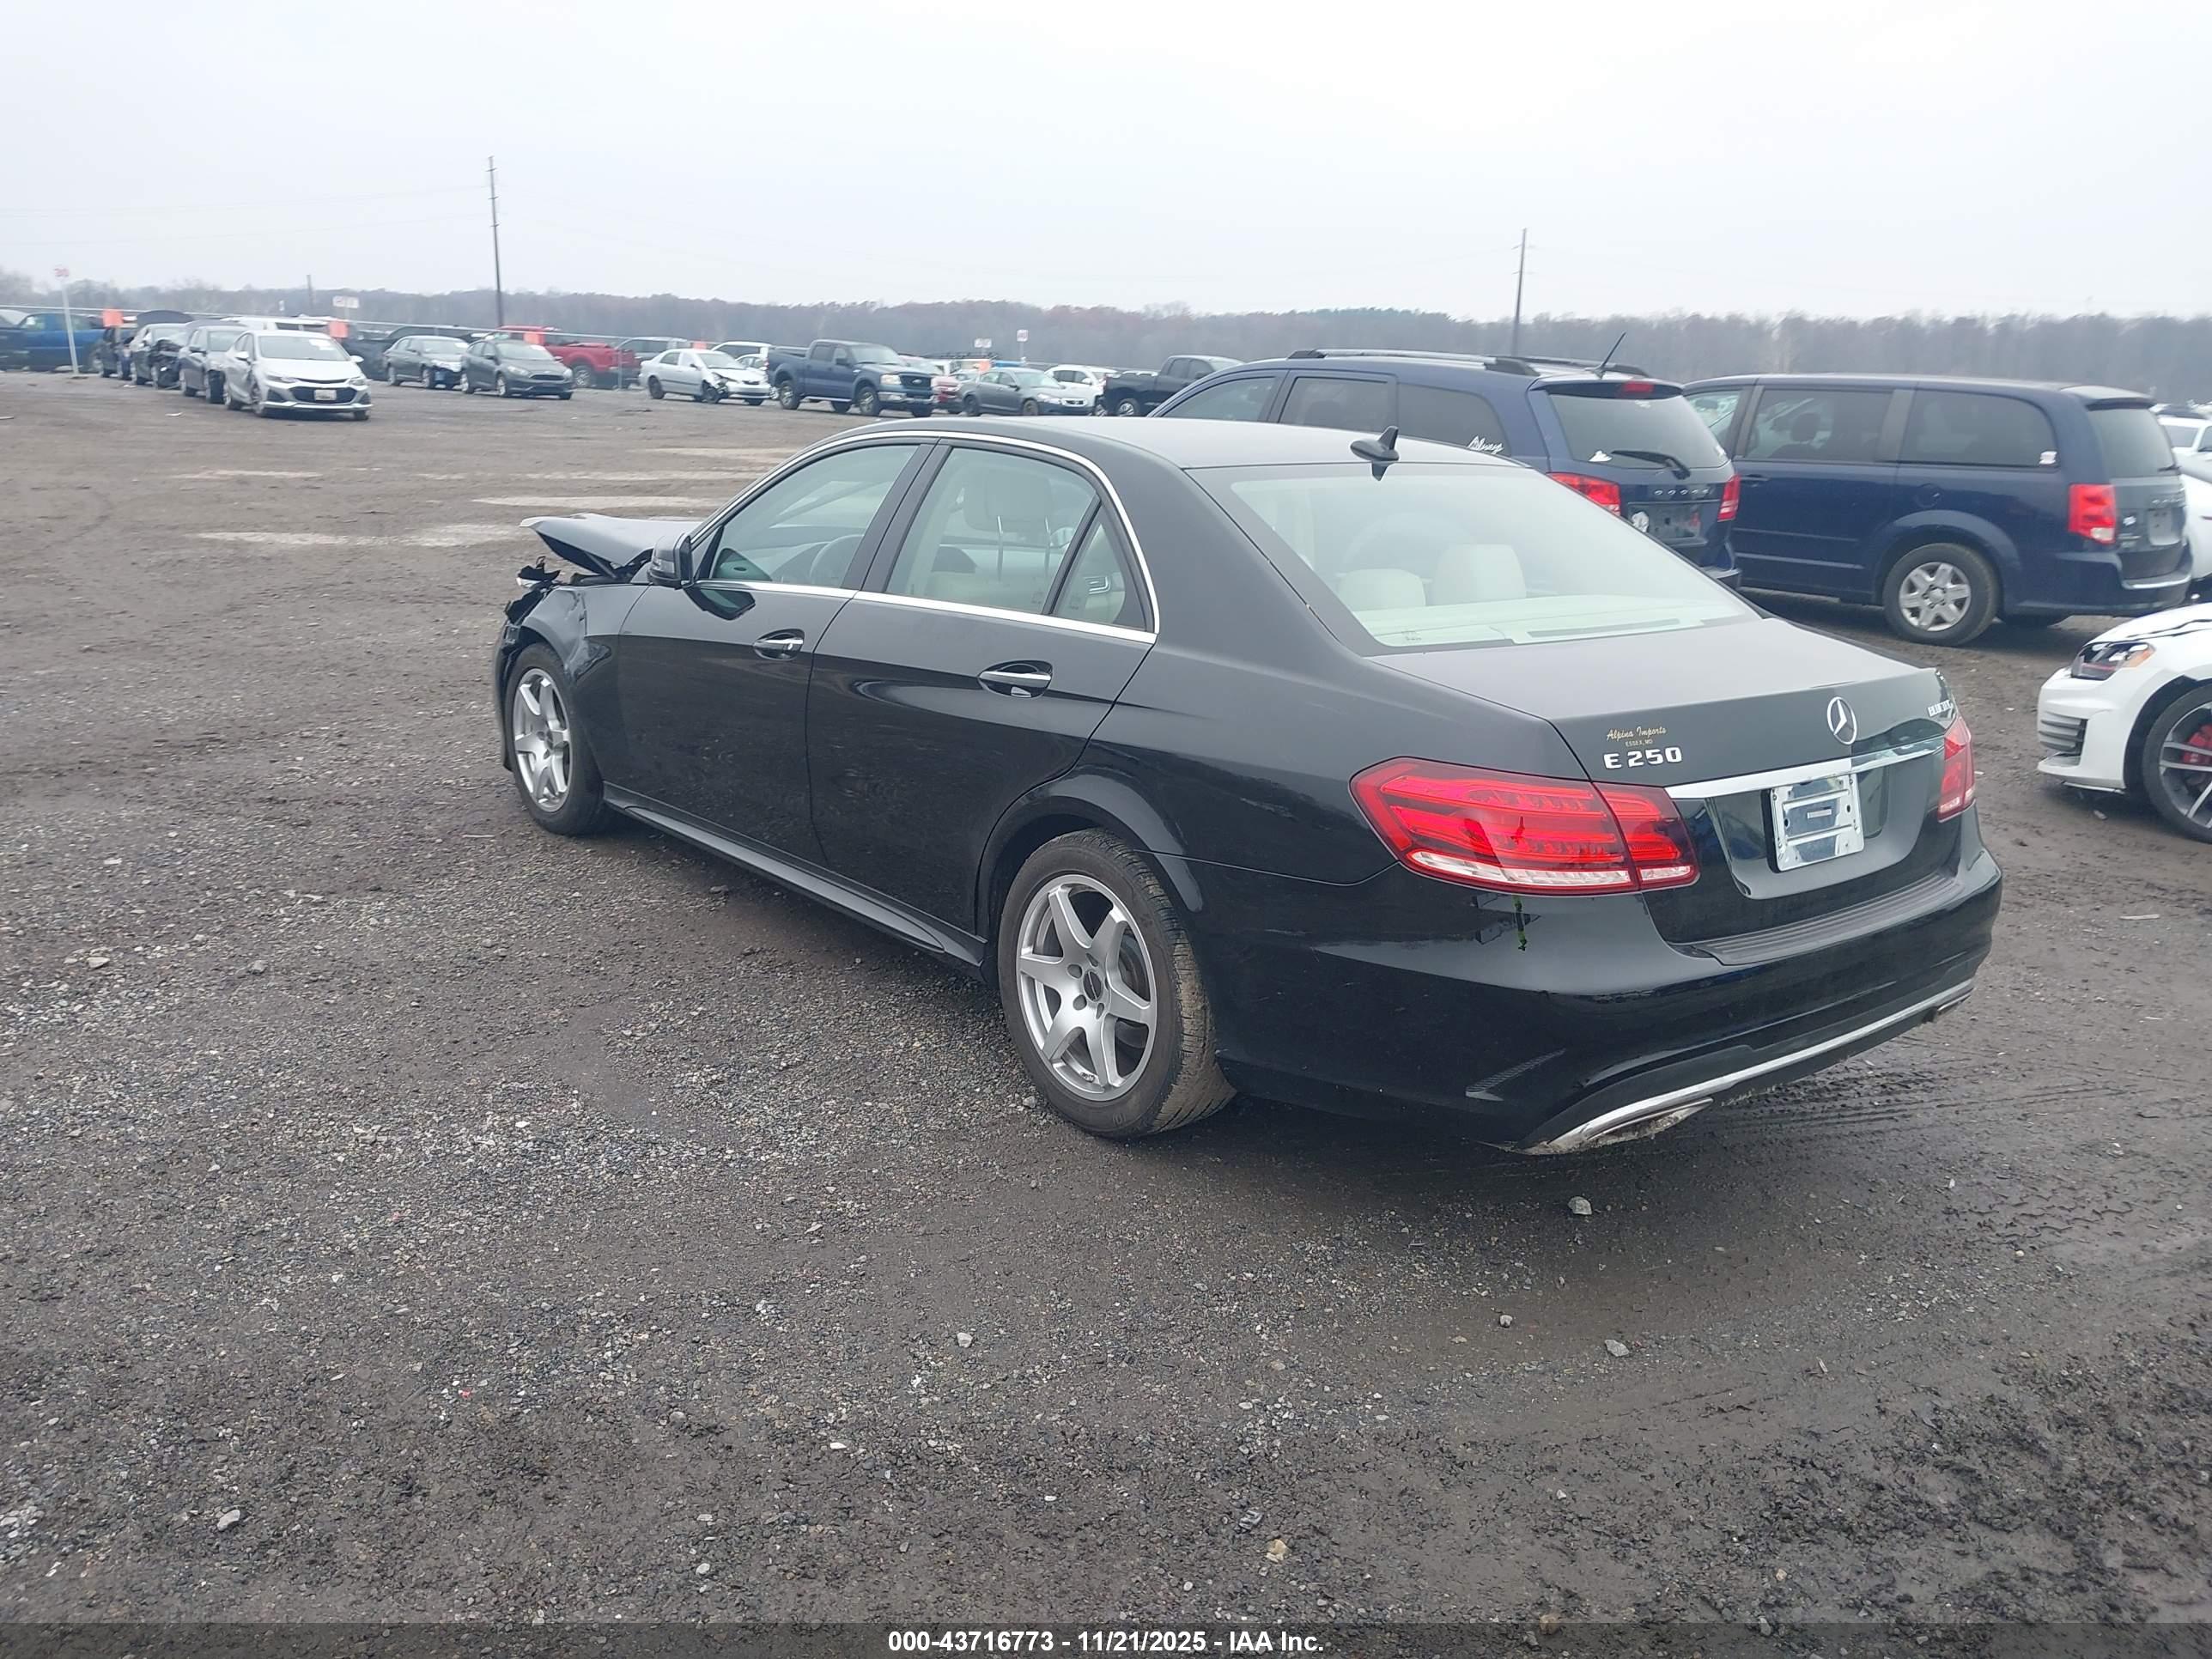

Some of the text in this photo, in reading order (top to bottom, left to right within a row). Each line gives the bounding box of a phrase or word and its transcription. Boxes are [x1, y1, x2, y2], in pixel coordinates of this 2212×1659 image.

[1636, 726, 1667, 738] Imports
[1603, 746, 1682, 769] E 250
